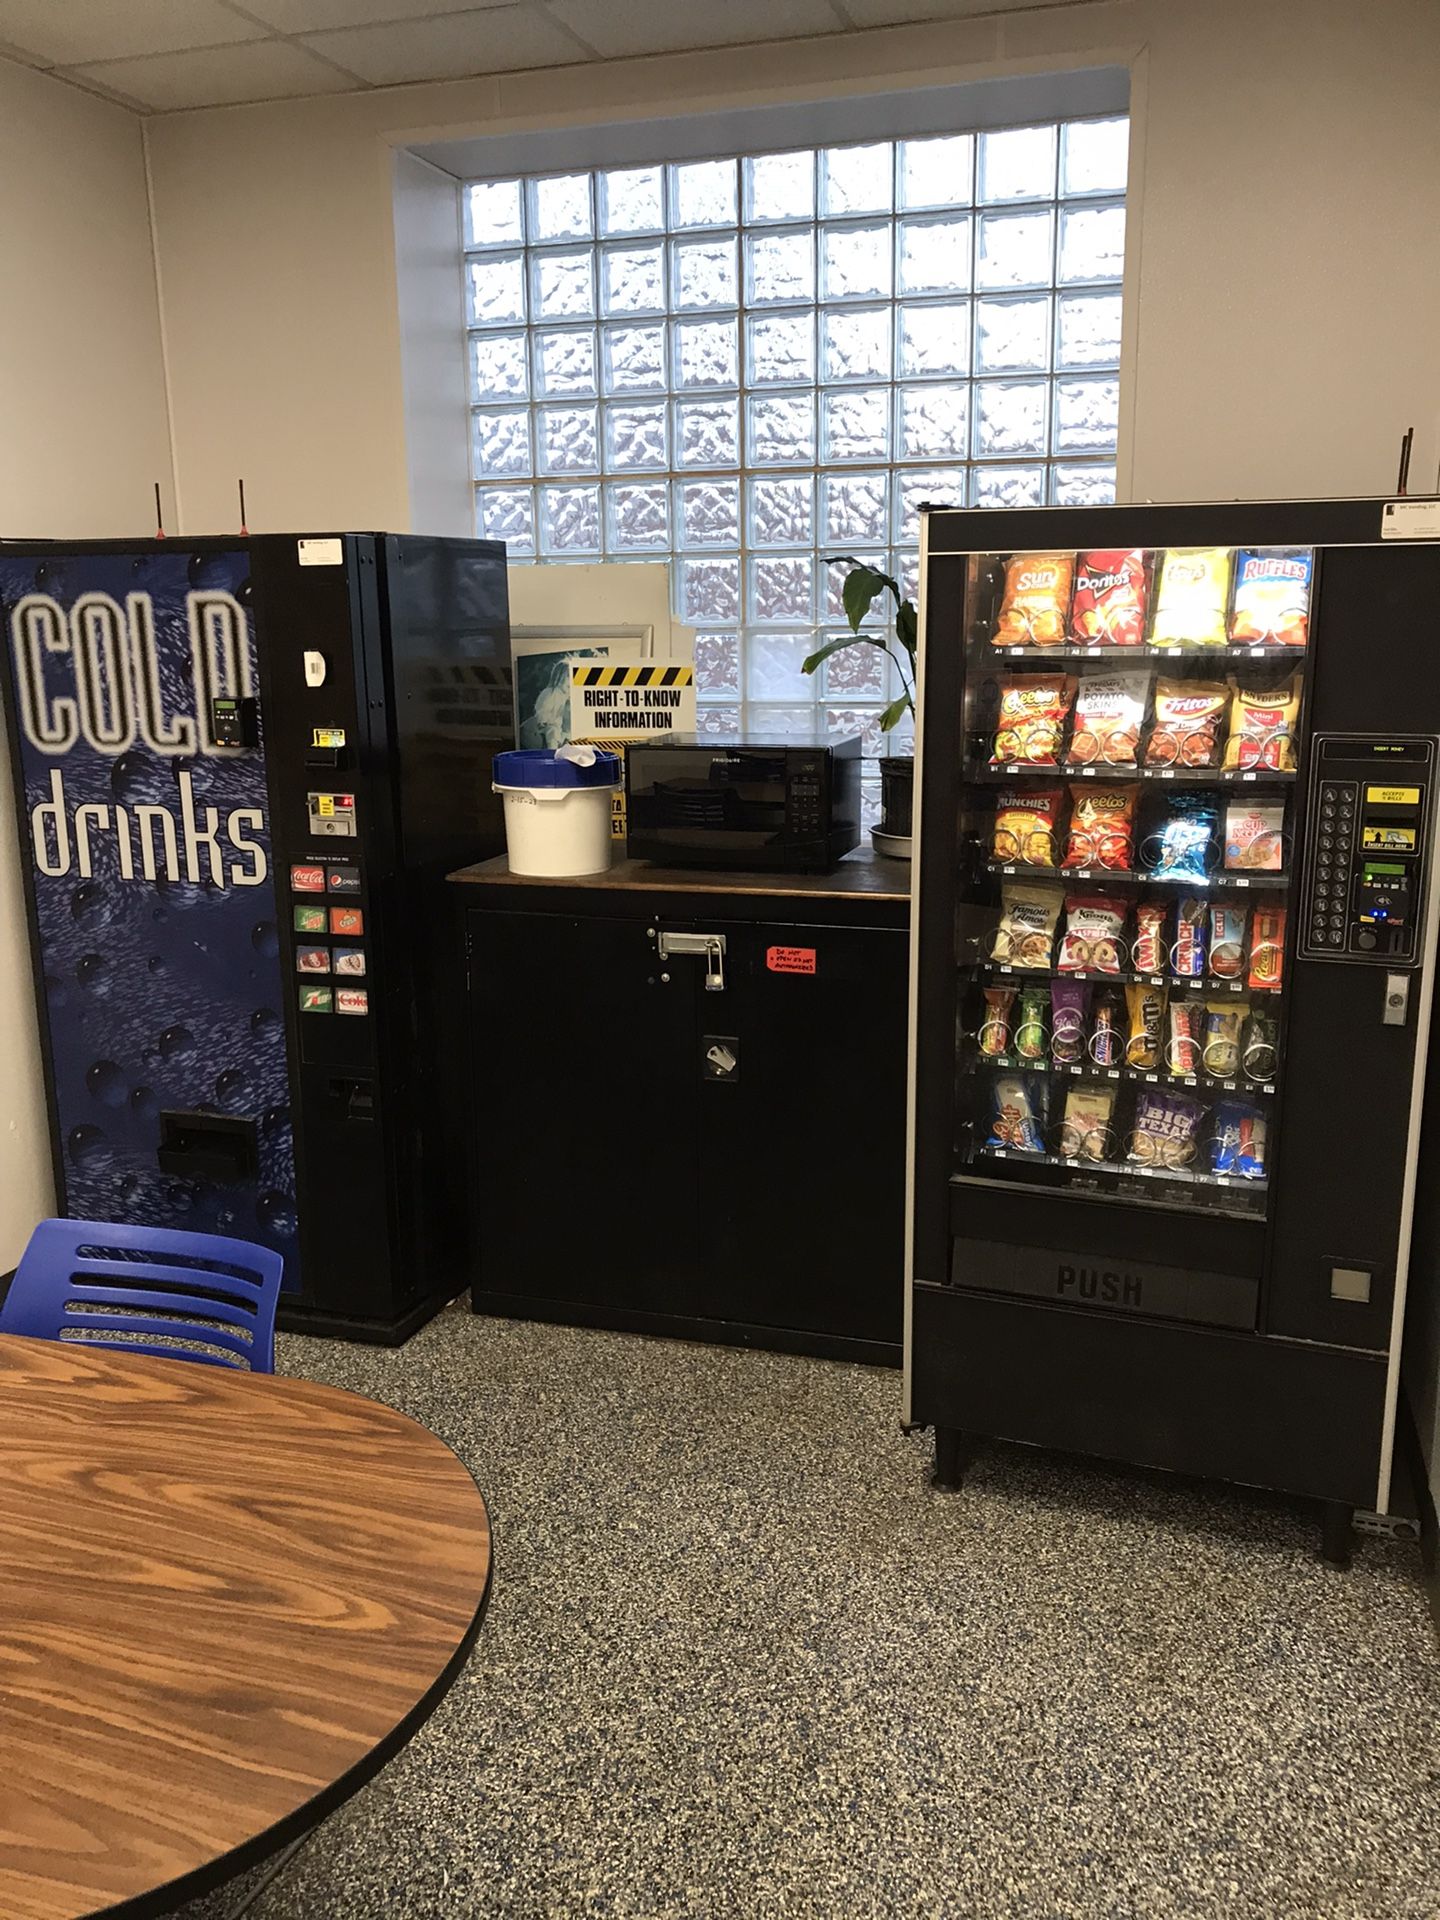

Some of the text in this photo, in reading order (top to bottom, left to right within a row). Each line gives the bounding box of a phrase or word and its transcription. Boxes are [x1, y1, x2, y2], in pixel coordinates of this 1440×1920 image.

[1244, 558, 1307, 580] RUFFLES
[1016, 571, 1056, 591] Sun
[1077, 570, 1131, 592] Doritos
[11, 590, 258, 757] COLD
[1083, 691, 1125, 702] POTATO
[594, 712, 672, 728] INFORMATION
[997, 797, 1051, 812] MUNCHIES
[31, 768, 268, 890] drinks
[1008, 903, 1051, 917] Famous
[1139, 1117, 1191, 1137] TEXAS
[1145, 1106, 1193, 1129] BIG
[1057, 1265, 1143, 1307] PUSH
